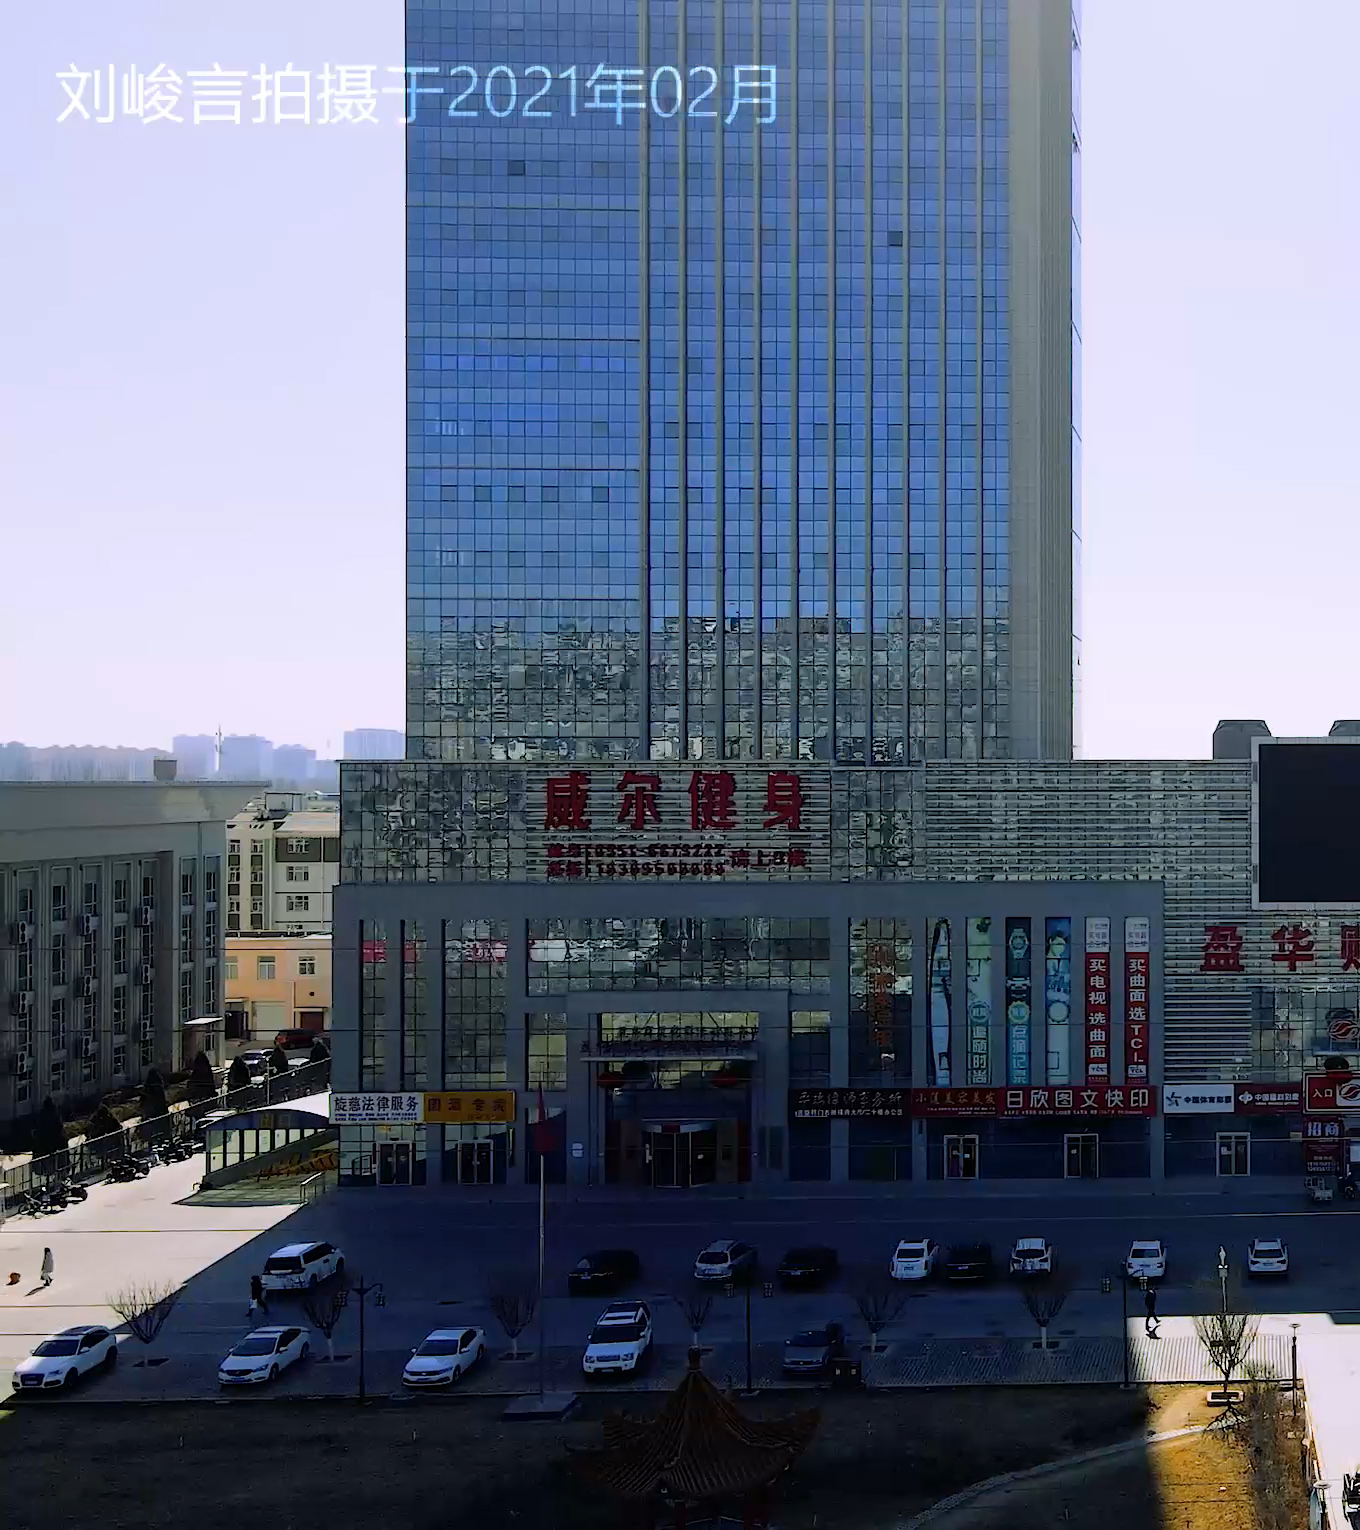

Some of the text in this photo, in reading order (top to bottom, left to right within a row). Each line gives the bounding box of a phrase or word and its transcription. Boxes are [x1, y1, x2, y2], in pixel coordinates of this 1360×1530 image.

[544, 769, 805, 831] 威尔健身
[1312, 1087, 1334, 1099] 入口
